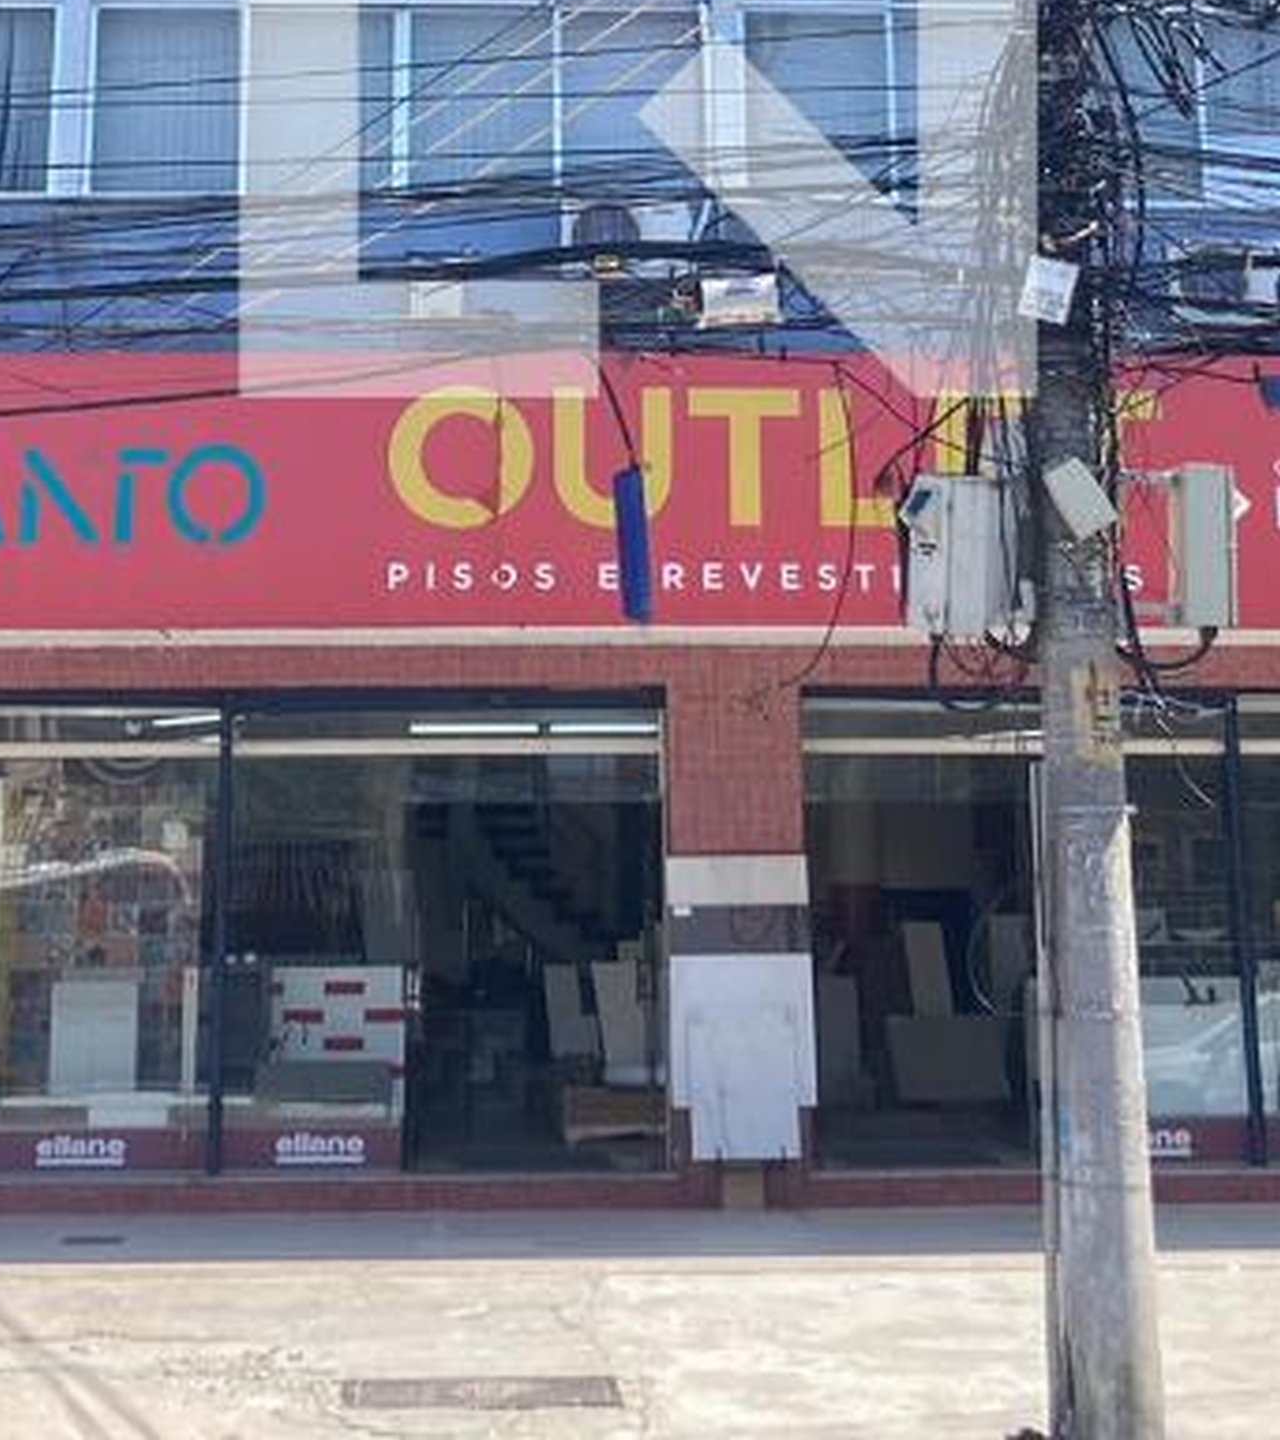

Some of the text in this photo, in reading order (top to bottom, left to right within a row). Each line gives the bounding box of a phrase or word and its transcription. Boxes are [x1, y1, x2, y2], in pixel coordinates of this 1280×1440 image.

[387, 385, 1163, 530] OUTL
[387, 563, 1145, 591] PISOS E REVESTIS
